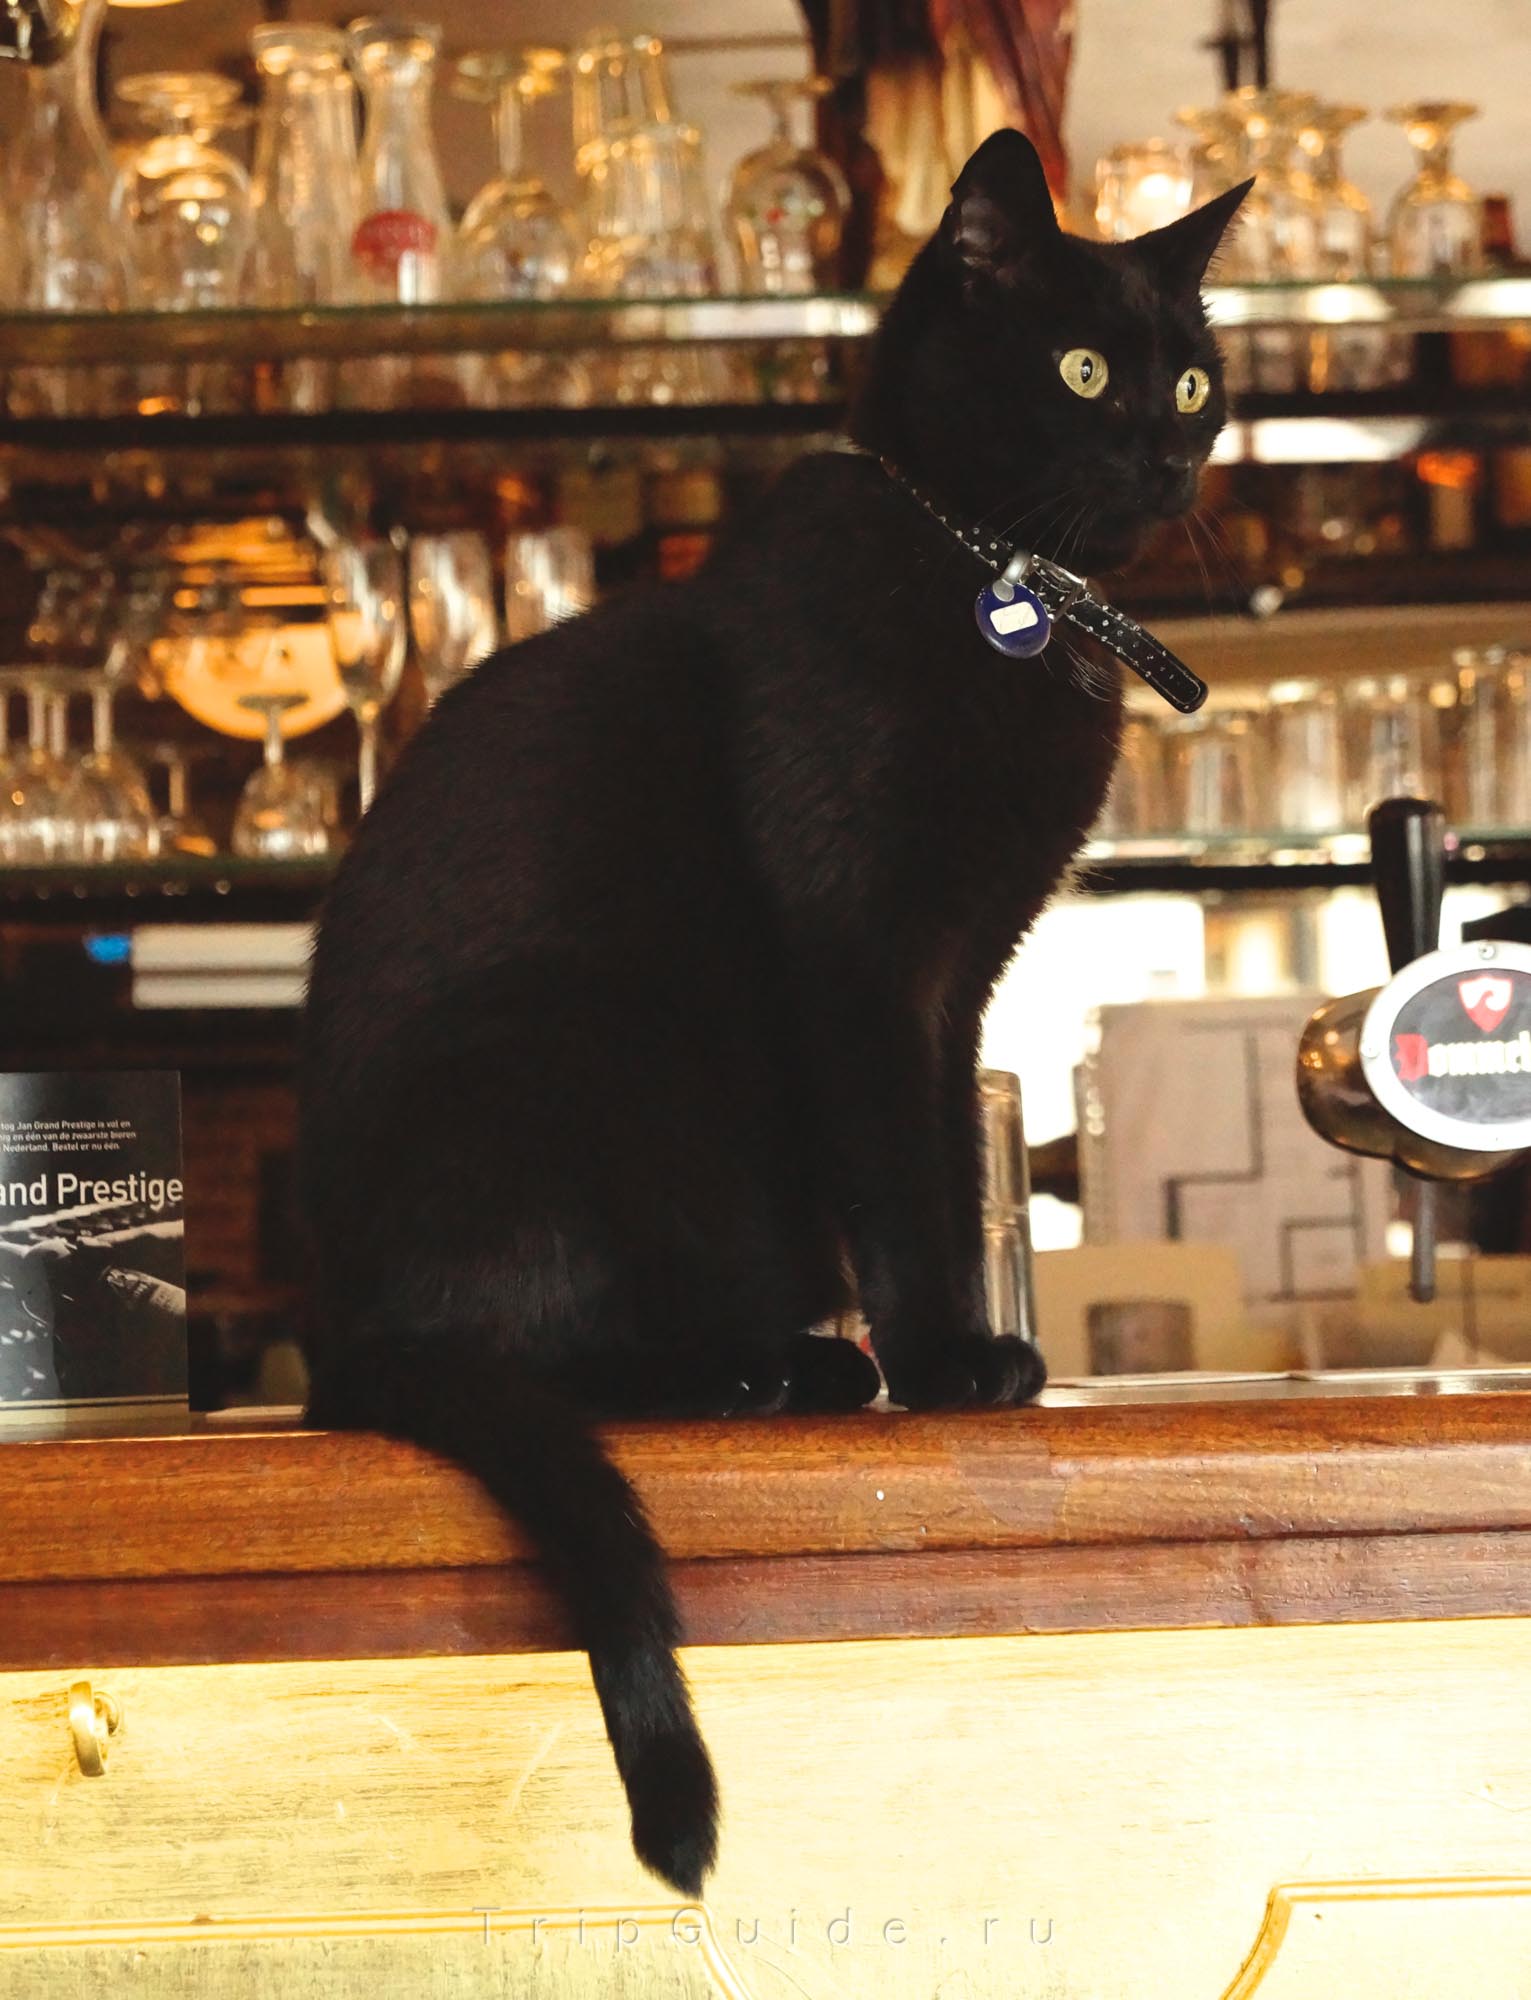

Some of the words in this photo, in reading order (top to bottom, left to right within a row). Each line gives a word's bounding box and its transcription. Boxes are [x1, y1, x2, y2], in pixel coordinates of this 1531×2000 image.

[17, 1121, 32, 1131] Jan
[34, 1120, 60, 1130] Grand
[61, 1120, 96, 1131] Prestige
[106, 1120, 119, 1129] vol
[120, 1121, 131, 1129] en
[12, 1133, 24, 1141] en
[42, 1132, 58, 1140] van
[59, 1132, 70, 1140] de
[52, 1141, 79, 1152] Bestel
[80, 1143, 89, 1151] er
[57, 1171, 183, 1212] Prestige
